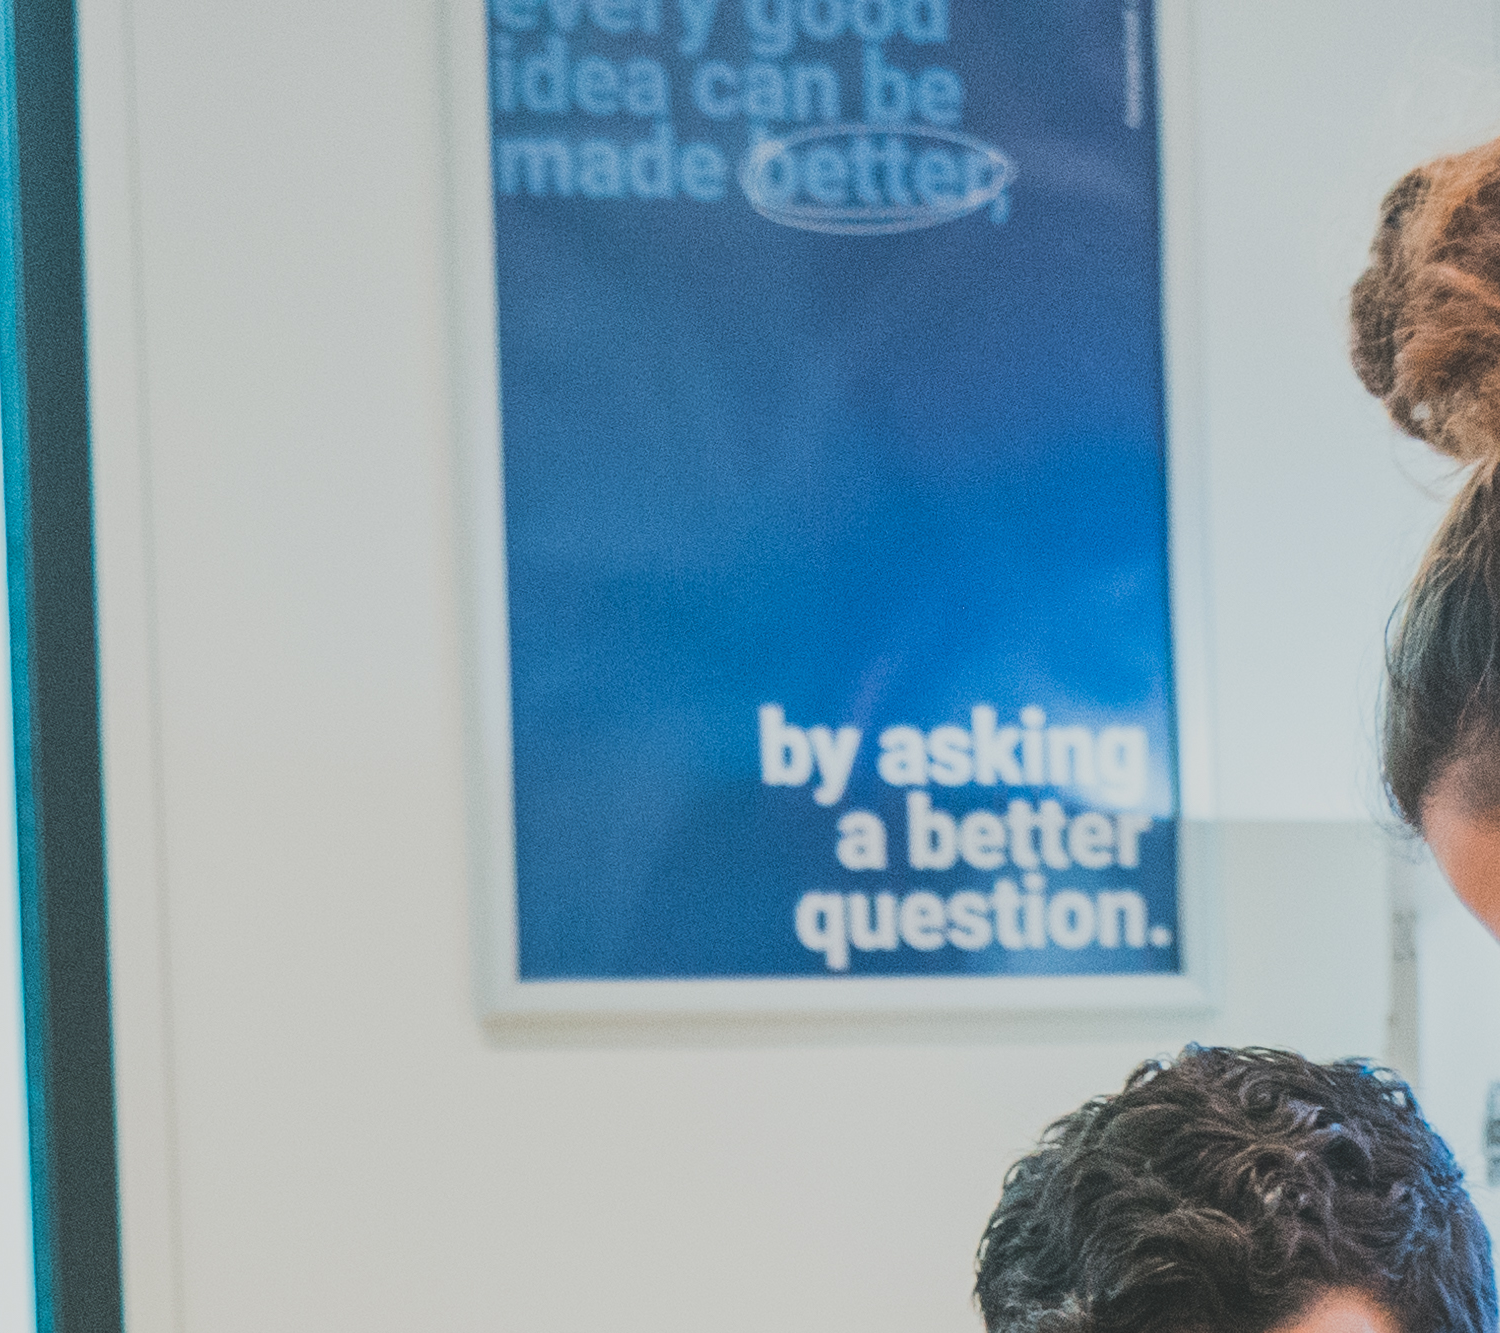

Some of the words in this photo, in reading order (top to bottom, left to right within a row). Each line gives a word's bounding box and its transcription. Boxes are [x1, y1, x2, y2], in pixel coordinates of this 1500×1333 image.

[499, 34, 666, 115] idea
[694, 60, 840, 119] can
[864, 40, 964, 125] be
[502, 120, 727, 200] made
[759, 703, 863, 807] by
[877, 704, 1149, 806] asking
[835, 810, 888, 871] a
[905, 791, 1153, 871] better
[795, 873, 1171, 972] question.
